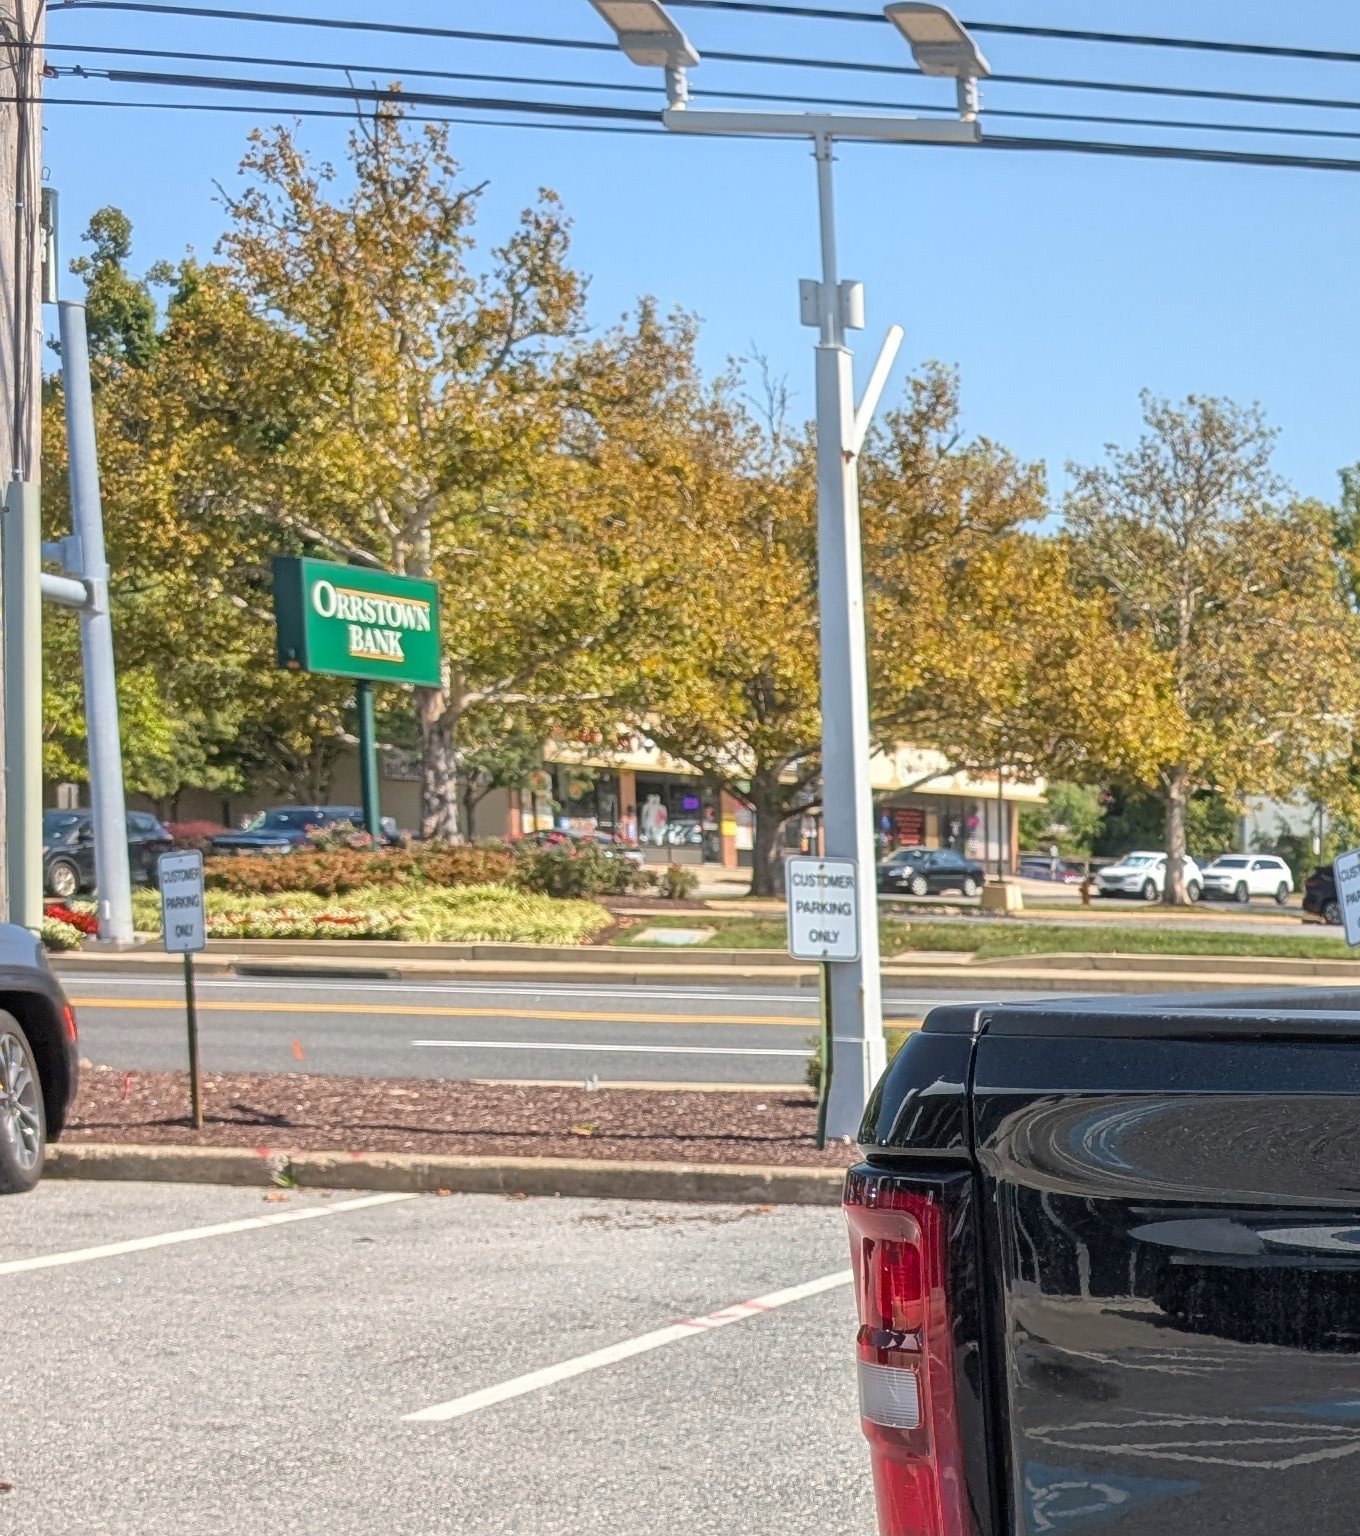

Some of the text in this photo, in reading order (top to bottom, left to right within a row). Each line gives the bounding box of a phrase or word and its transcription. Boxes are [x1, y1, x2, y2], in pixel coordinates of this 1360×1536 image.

[313, 580, 430, 632] ORRSTOWN
[348, 624, 404, 657] BANK
[792, 872, 856, 889] CUSTOMER
[166, 893, 200, 909] PARKING
[795, 900, 852, 917] PARKING
[175, 924, 193, 938] ONLY
[808, 928, 840, 944] ONLY
